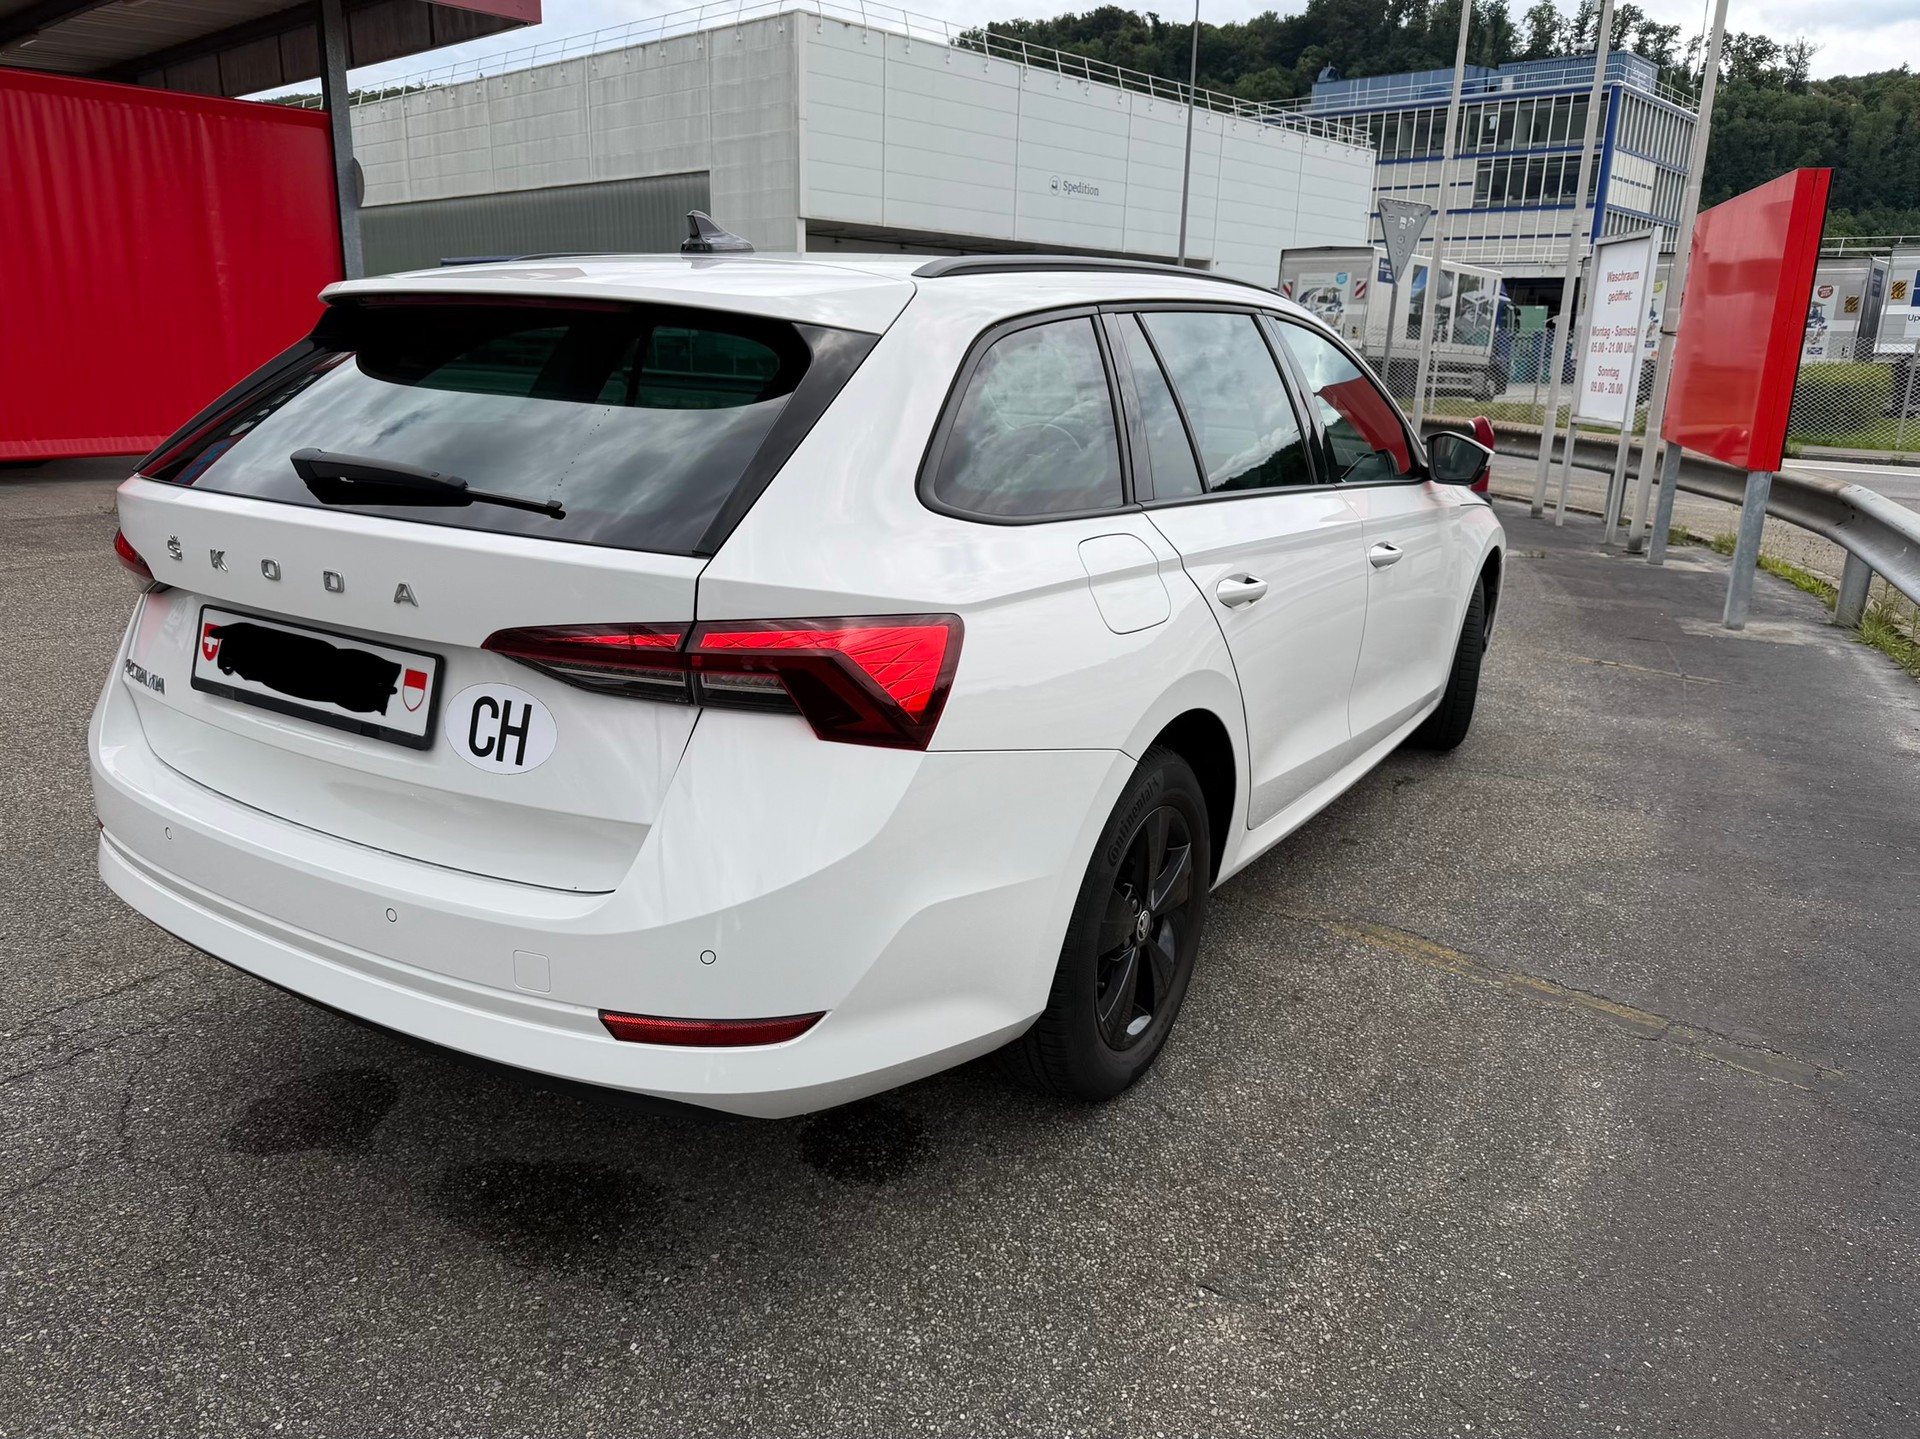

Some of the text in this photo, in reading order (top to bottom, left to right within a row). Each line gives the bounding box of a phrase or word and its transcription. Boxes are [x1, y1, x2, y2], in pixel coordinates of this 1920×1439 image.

[1062, 180, 1100, 197] Spedition
[1606, 270, 1640, 283] Waschraum
[1591, 326, 1611, 339] Montag
[1614, 325, 1637, 337] Samsta
[1590, 341, 1605, 353] 05.00
[1608, 341, 1624, 354] 21.00
[1597, 365, 1620, 381] Sonntag
[1590, 381, 1605, 393] 09.00
[1608, 382, 1624, 395] 20.00
[468, 695, 533, 767] CH
[1106, 778, 1154, 868] Continental
